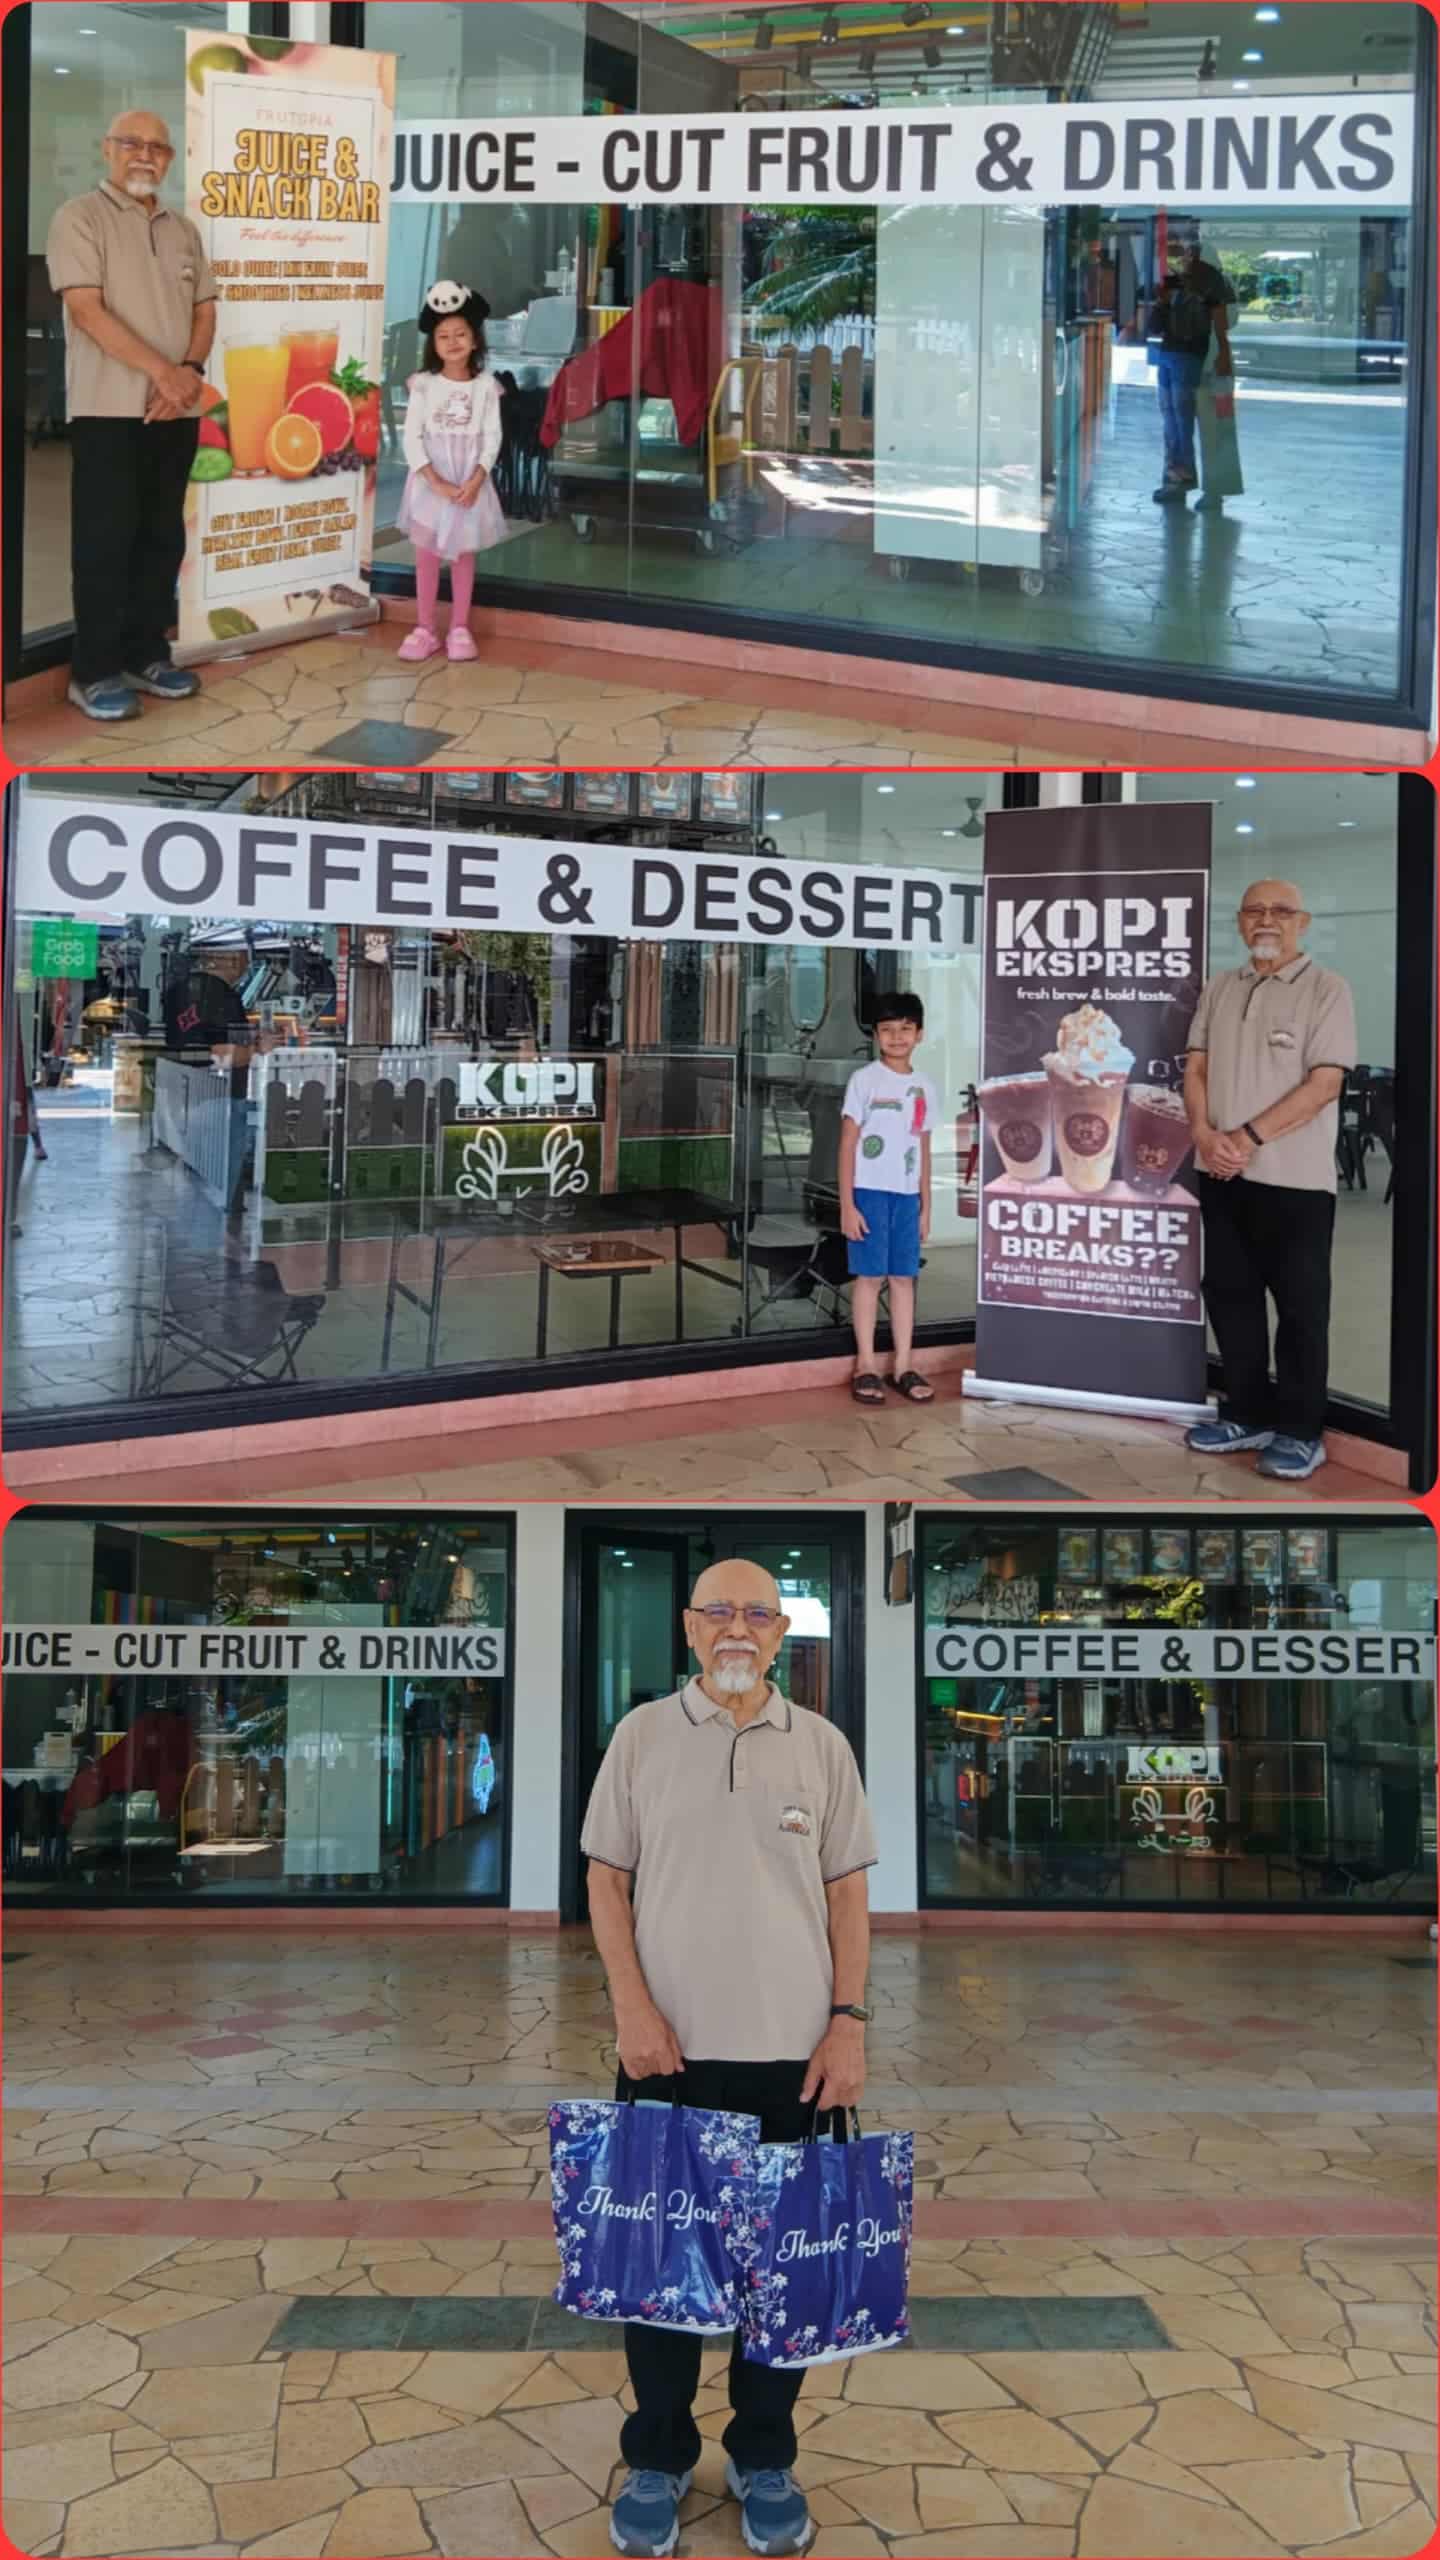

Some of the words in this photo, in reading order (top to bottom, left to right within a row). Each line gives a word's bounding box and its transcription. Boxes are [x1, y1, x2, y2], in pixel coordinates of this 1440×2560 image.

[255, 109, 336, 127] FRUTOPIA
[234, 128, 329, 177] JUICE
[334, 136, 359, 179] &
[390, 132, 535, 192] JUICE
[557, 161, 579, 173] -
[602, 128, 725, 192] CUT
[747, 123, 952, 193] FRUIT
[975, 122, 1033, 191] &
[1063, 112, 1395, 192] DRINKS
[200, 170, 313, 220] SNACK
[316, 176, 381, 223] BAR
[47, 814, 499, 919] COFFEE
[537, 853, 595, 925] &
[631, 858, 984, 946] DESSERT
[995, 896, 1193, 949] KOPI
[43, 951, 86, 967] Food
[44, 938, 86, 950] Grab
[995, 950, 1193, 978] EKSPRES
[1016, 986, 1050, 1001] fresh
[1052, 987, 1089, 1001] brew
[1089, 987, 1102, 1001] &
[1104, 987, 1137, 1001] bold
[1137, 989, 1177, 1002] taste.
[458, 1061, 596, 1105] KOPI
[457, 1105, 596, 1119] EKSPRES
[987, 1199, 1190, 1245] COFFEE
[1000, 1235, 1180, 1270] BREAKS??
[114, 1633, 187, 1668] CUT
[200, 1634, 307, 1669] FRUIT
[318, 1635, 346, 1670] &
[359, 1635, 498, 1671] DRINKS
[935, 1634, 1140, 1672] COFFEE
[1160, 1636, 1192, 1673] &
[577, 2185, 656, 2221] Thank
[666, 2189, 718, 2230] You
[776, 2222, 849, 2262] Thank
[856, 2217, 902, 2257] You
